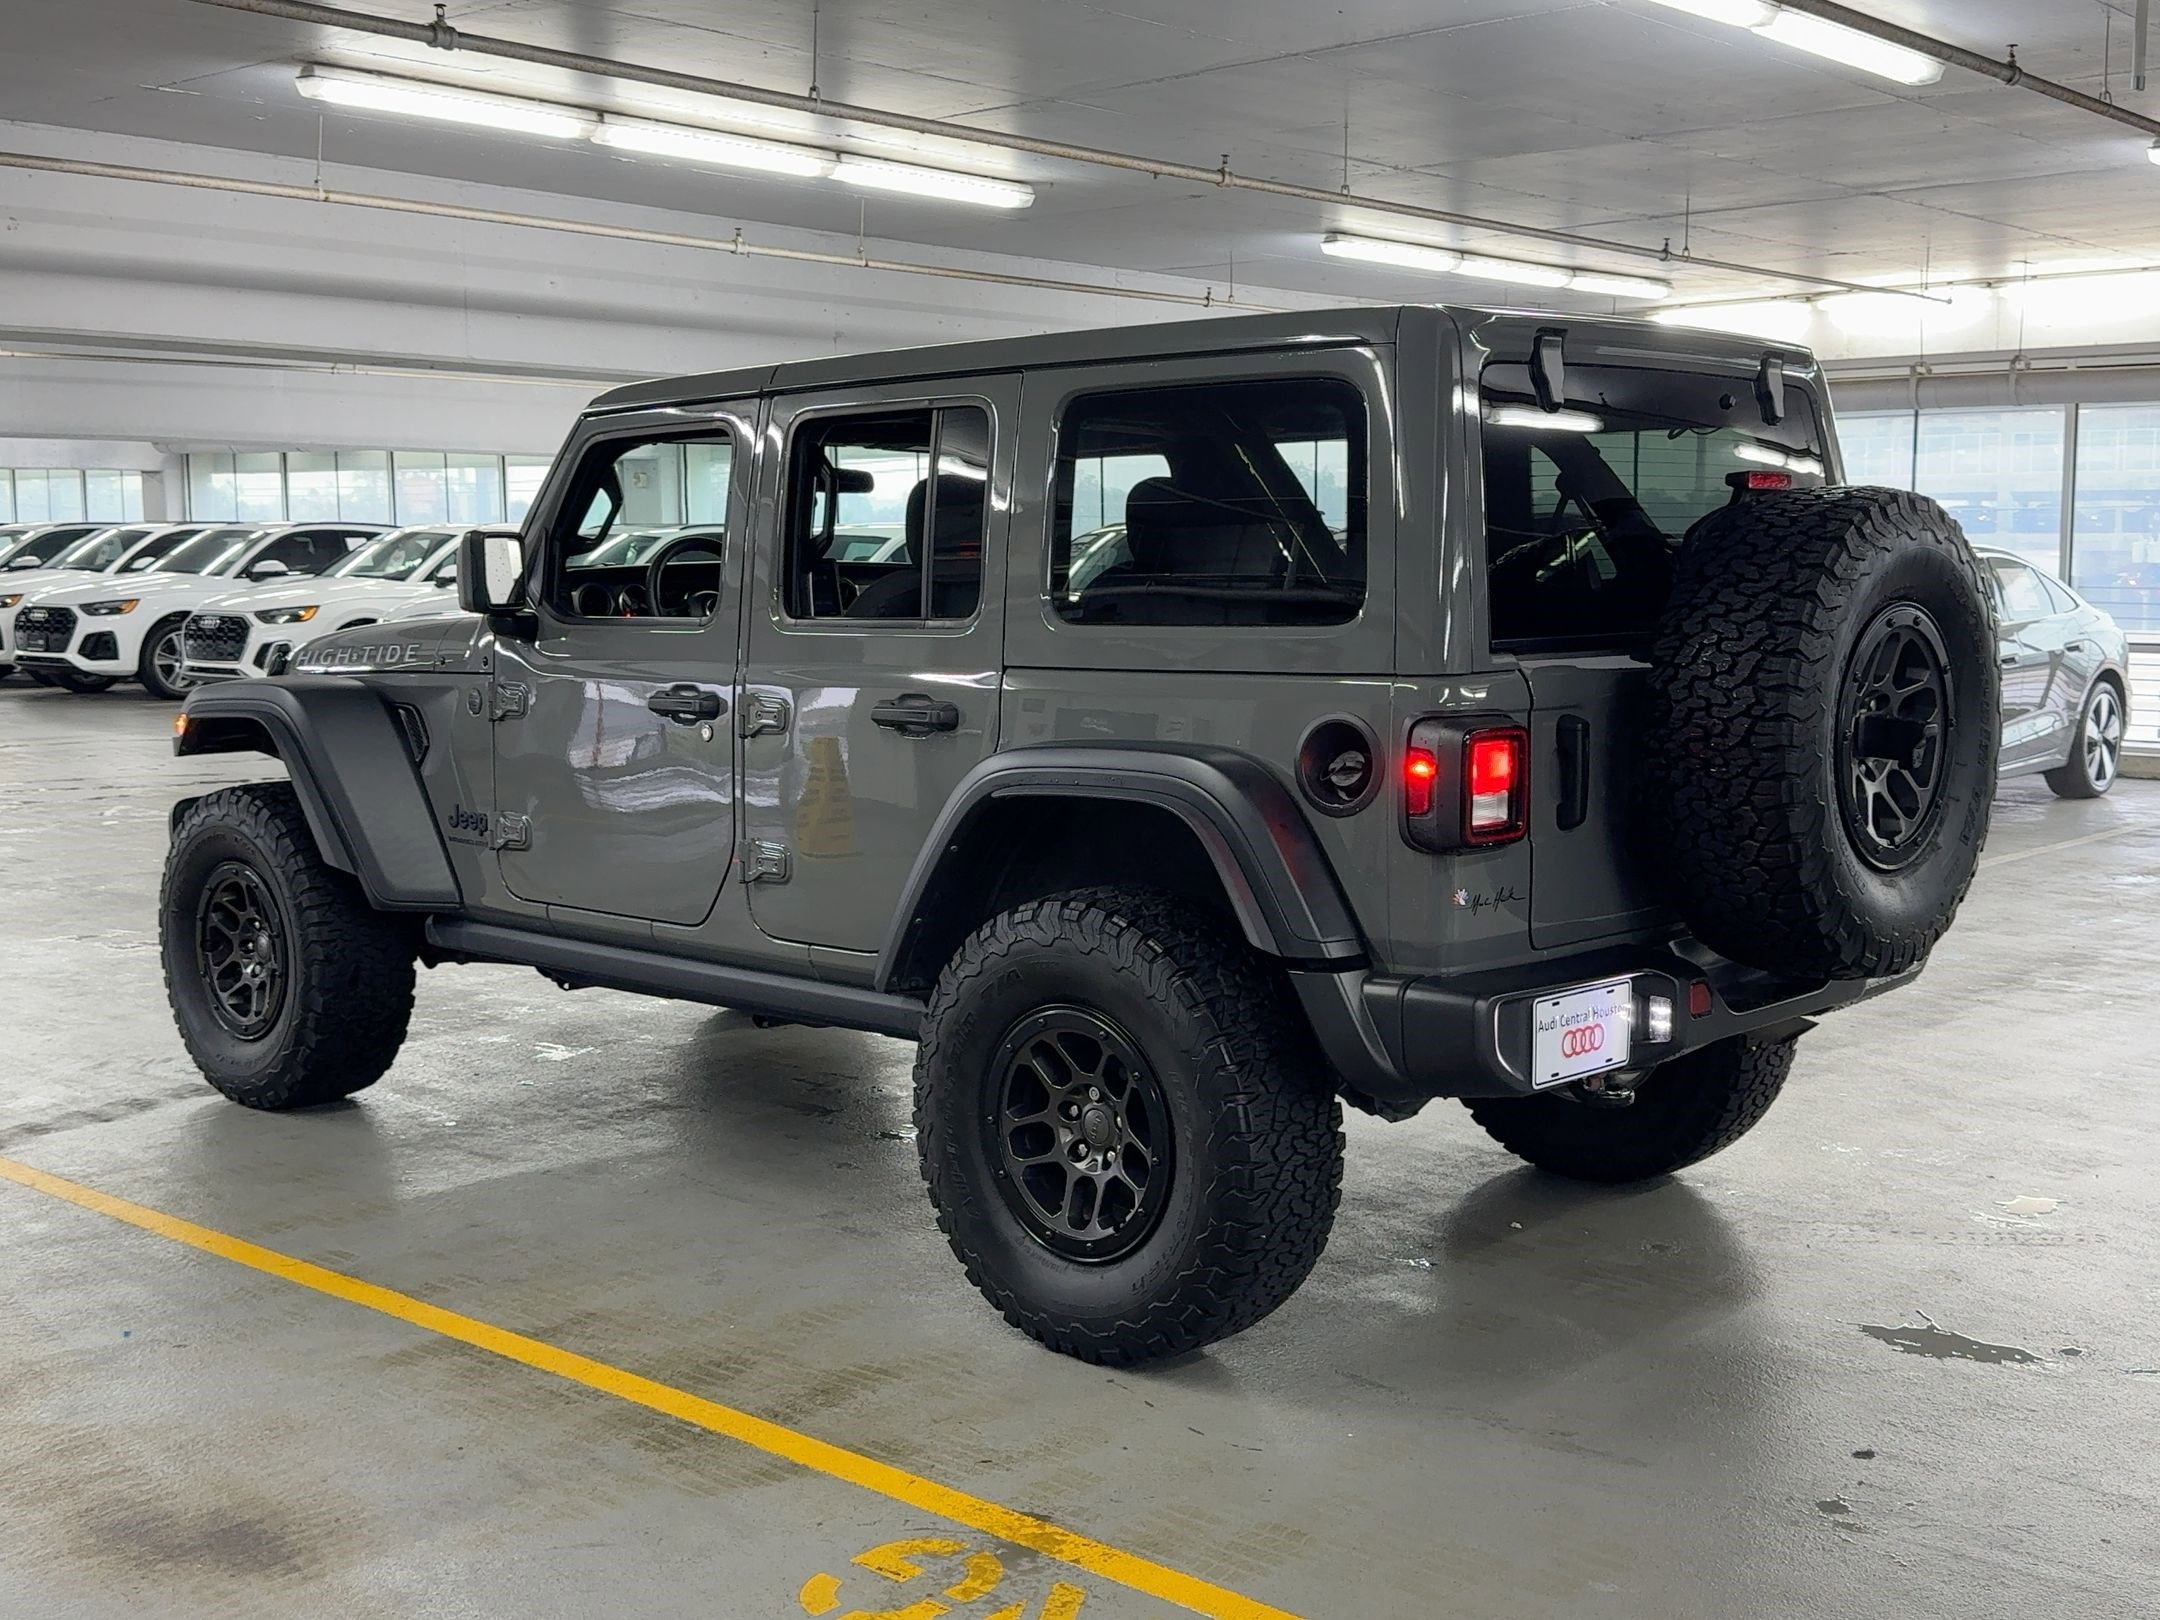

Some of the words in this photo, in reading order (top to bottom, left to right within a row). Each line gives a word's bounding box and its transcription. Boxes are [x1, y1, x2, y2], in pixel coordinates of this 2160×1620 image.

[362, 643, 421, 664] TIDE
[447, 803, 488, 836] Jeep
[1537, 1016, 1558, 1032] Audi
[1560, 1009, 1590, 1027] Central
